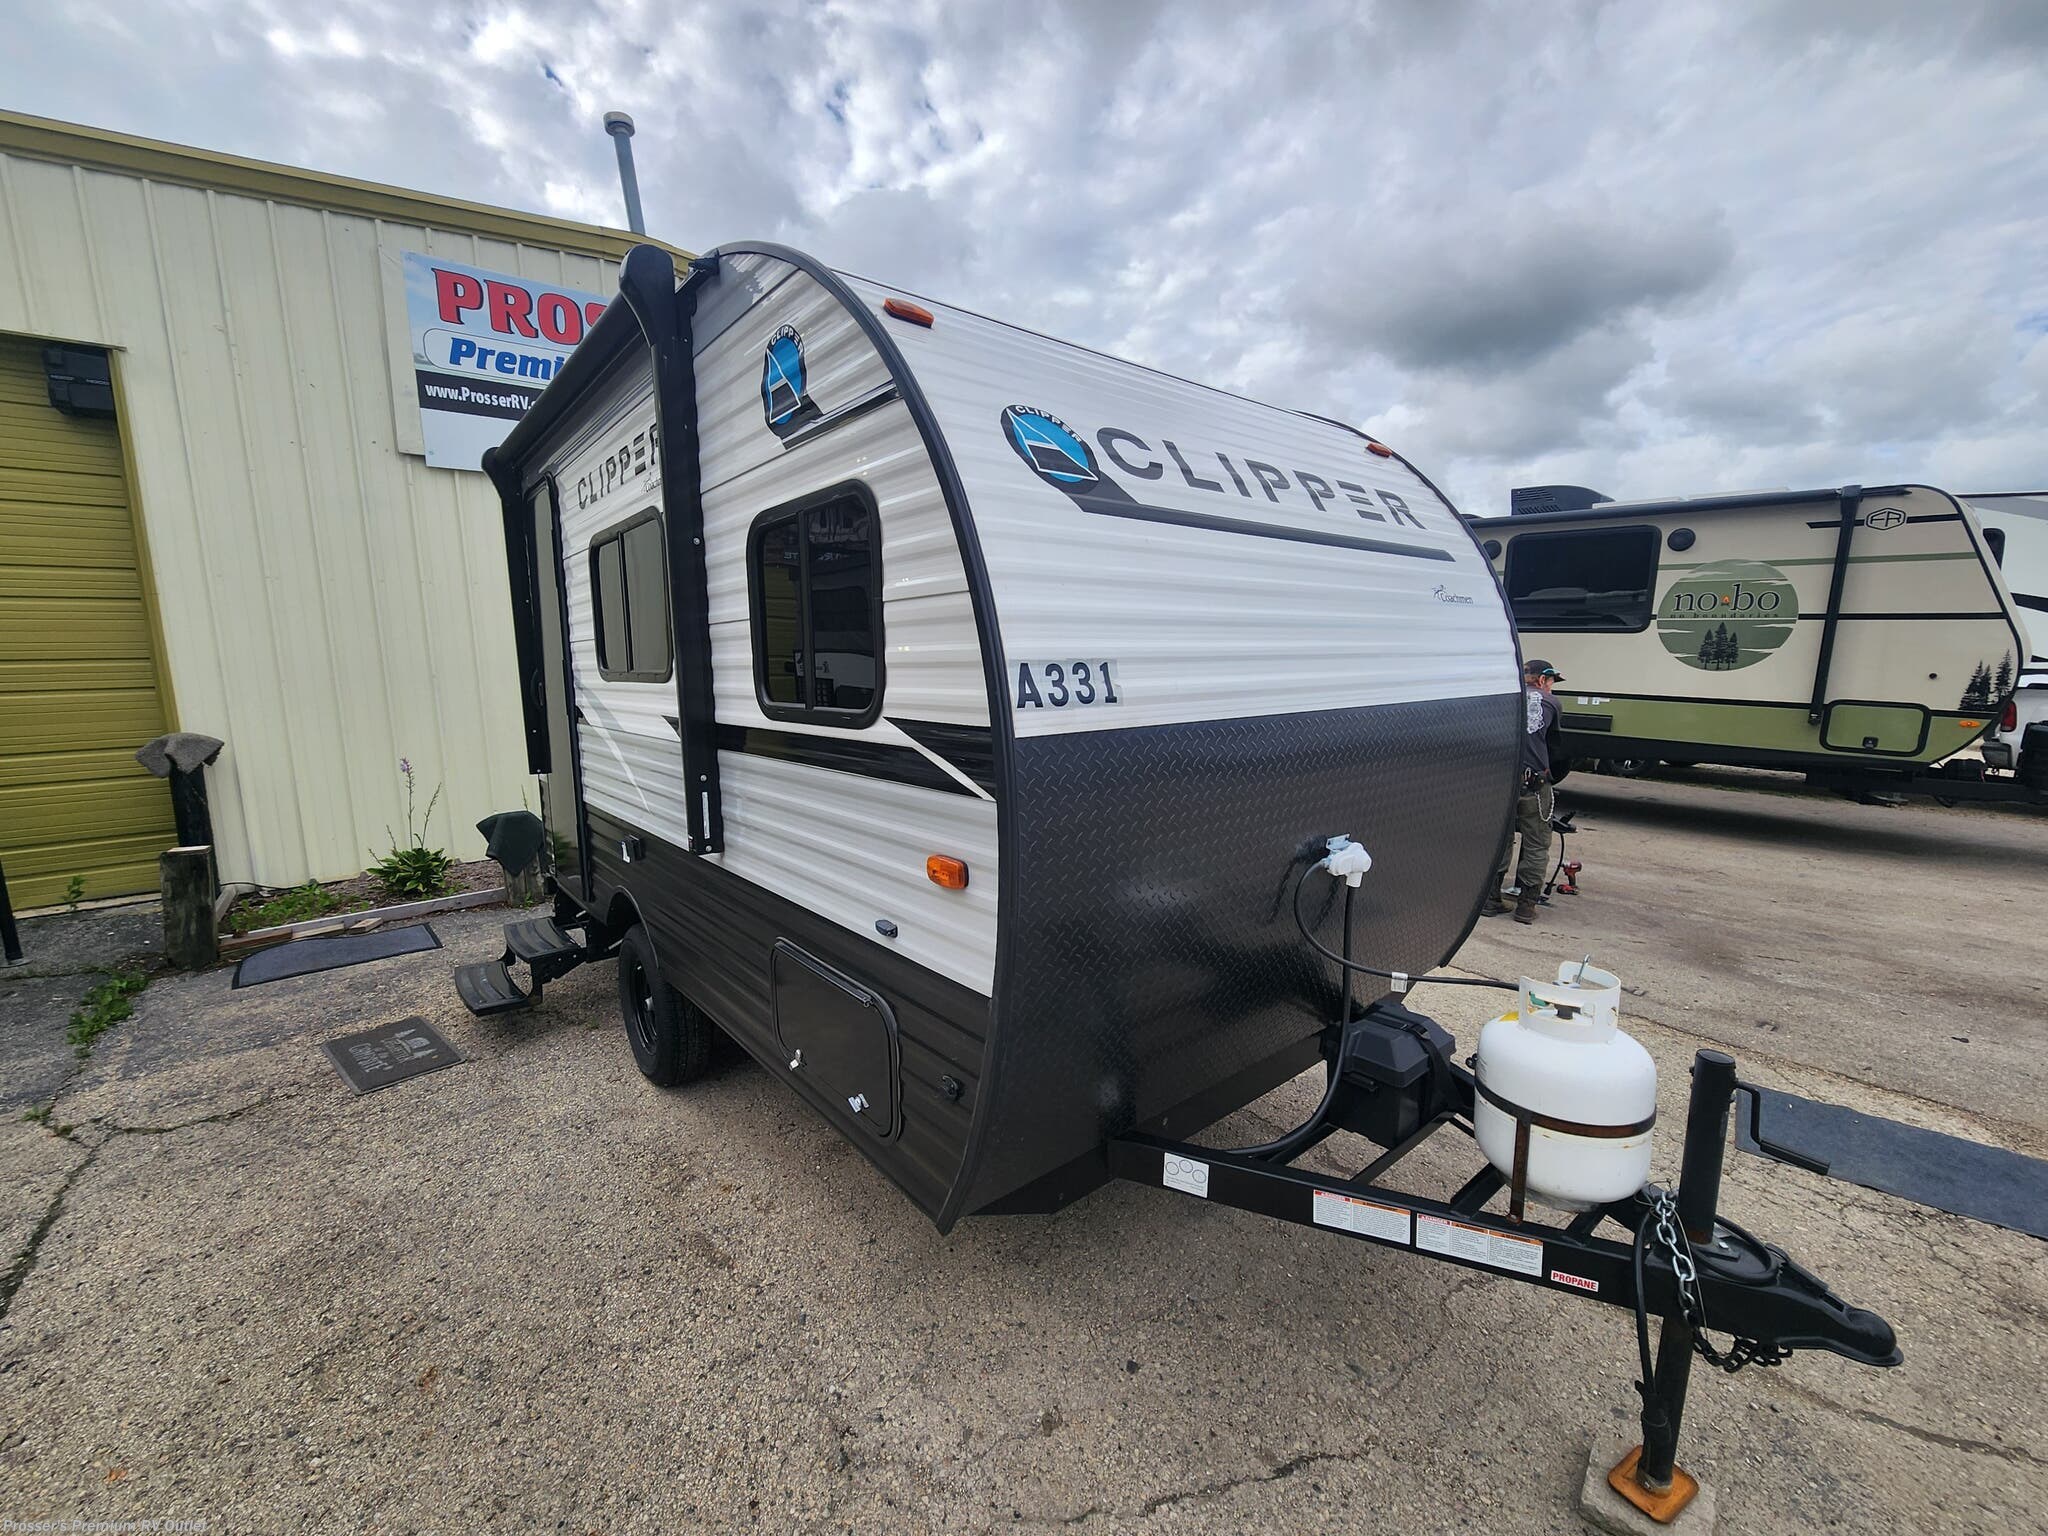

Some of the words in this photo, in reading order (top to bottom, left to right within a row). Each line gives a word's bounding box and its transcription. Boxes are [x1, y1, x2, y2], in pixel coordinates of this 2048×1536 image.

[770, 326, 803, 357] CLIPPER
[1015, 405, 1082, 442] CLIPPER
[1097, 427, 1427, 530] CLIPPER
[1016, 661, 1118, 709] A331
[1552, 1271, 1598, 1291] PROPANE
